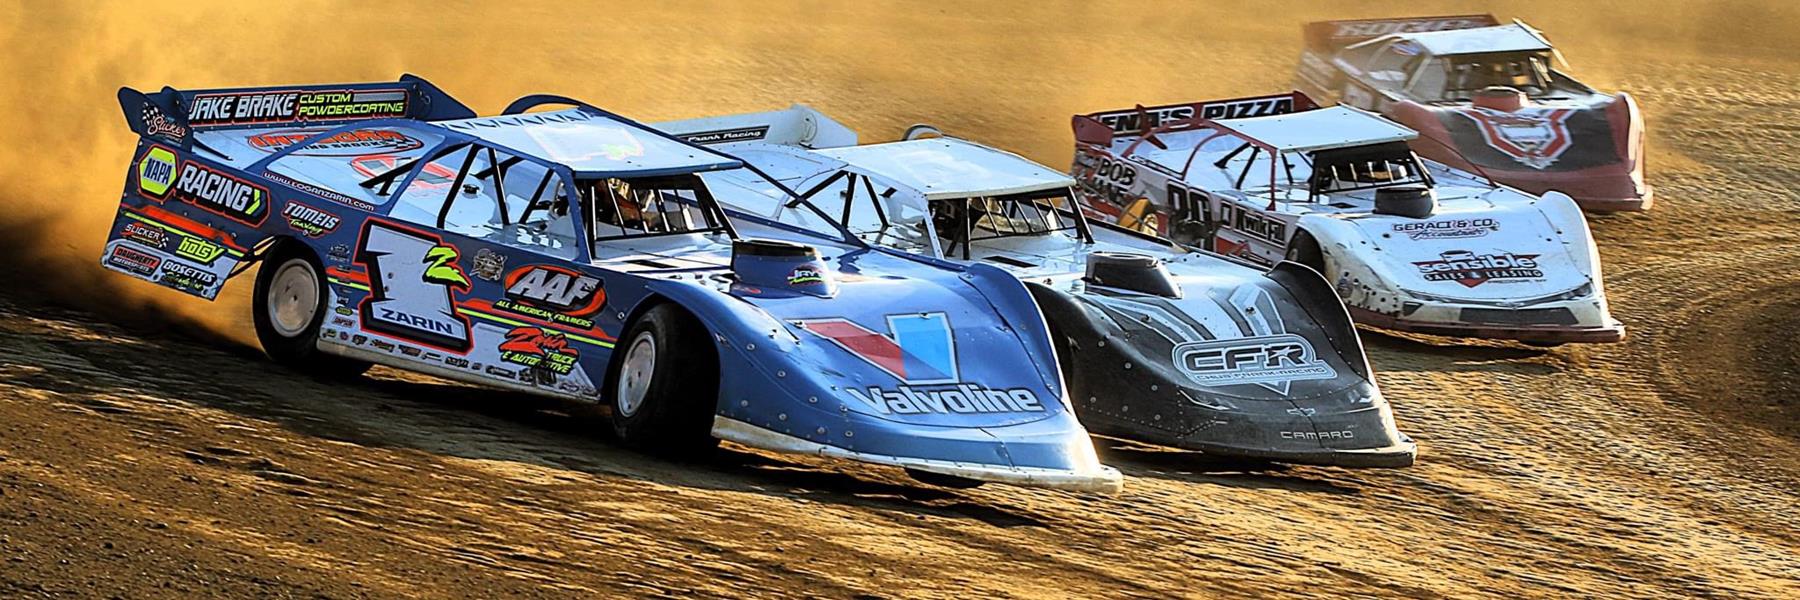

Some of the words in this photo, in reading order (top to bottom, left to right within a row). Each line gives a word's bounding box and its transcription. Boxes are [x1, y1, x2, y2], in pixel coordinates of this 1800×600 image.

[188, 96, 233, 120] JAKE
[235, 93, 299, 118] BRAKE
[298, 103, 404, 116] POWDERCOATING
[299, 93, 352, 104] CUSTOM
[1202, 98, 1293, 120] PIZZA
[143, 157, 172, 186] NAPA
[1097, 157, 1137, 186] BOB
[176, 163, 250, 212] RACING
[125, 223, 160, 240] SLICKER
[1393, 220, 1451, 232] GERACI
[1456, 219, 1468, 228] &
[1419, 253, 1538, 274] sensible
[365, 226, 462, 331] 1
[1425, 273, 1465, 282] SALES
[1484, 268, 1543, 279] LEASING
[507, 268, 600, 306] AAF
[496, 300, 510, 309] ALL
[512, 304, 552, 319] AMERICAN
[381, 307, 453, 335] ZARIN
[546, 351, 577, 365] TRUCK
[1184, 344, 1306, 371] CFR
[847, 383, 1045, 415] Valvoline
[1281, 431, 1353, 441] CAMARO
